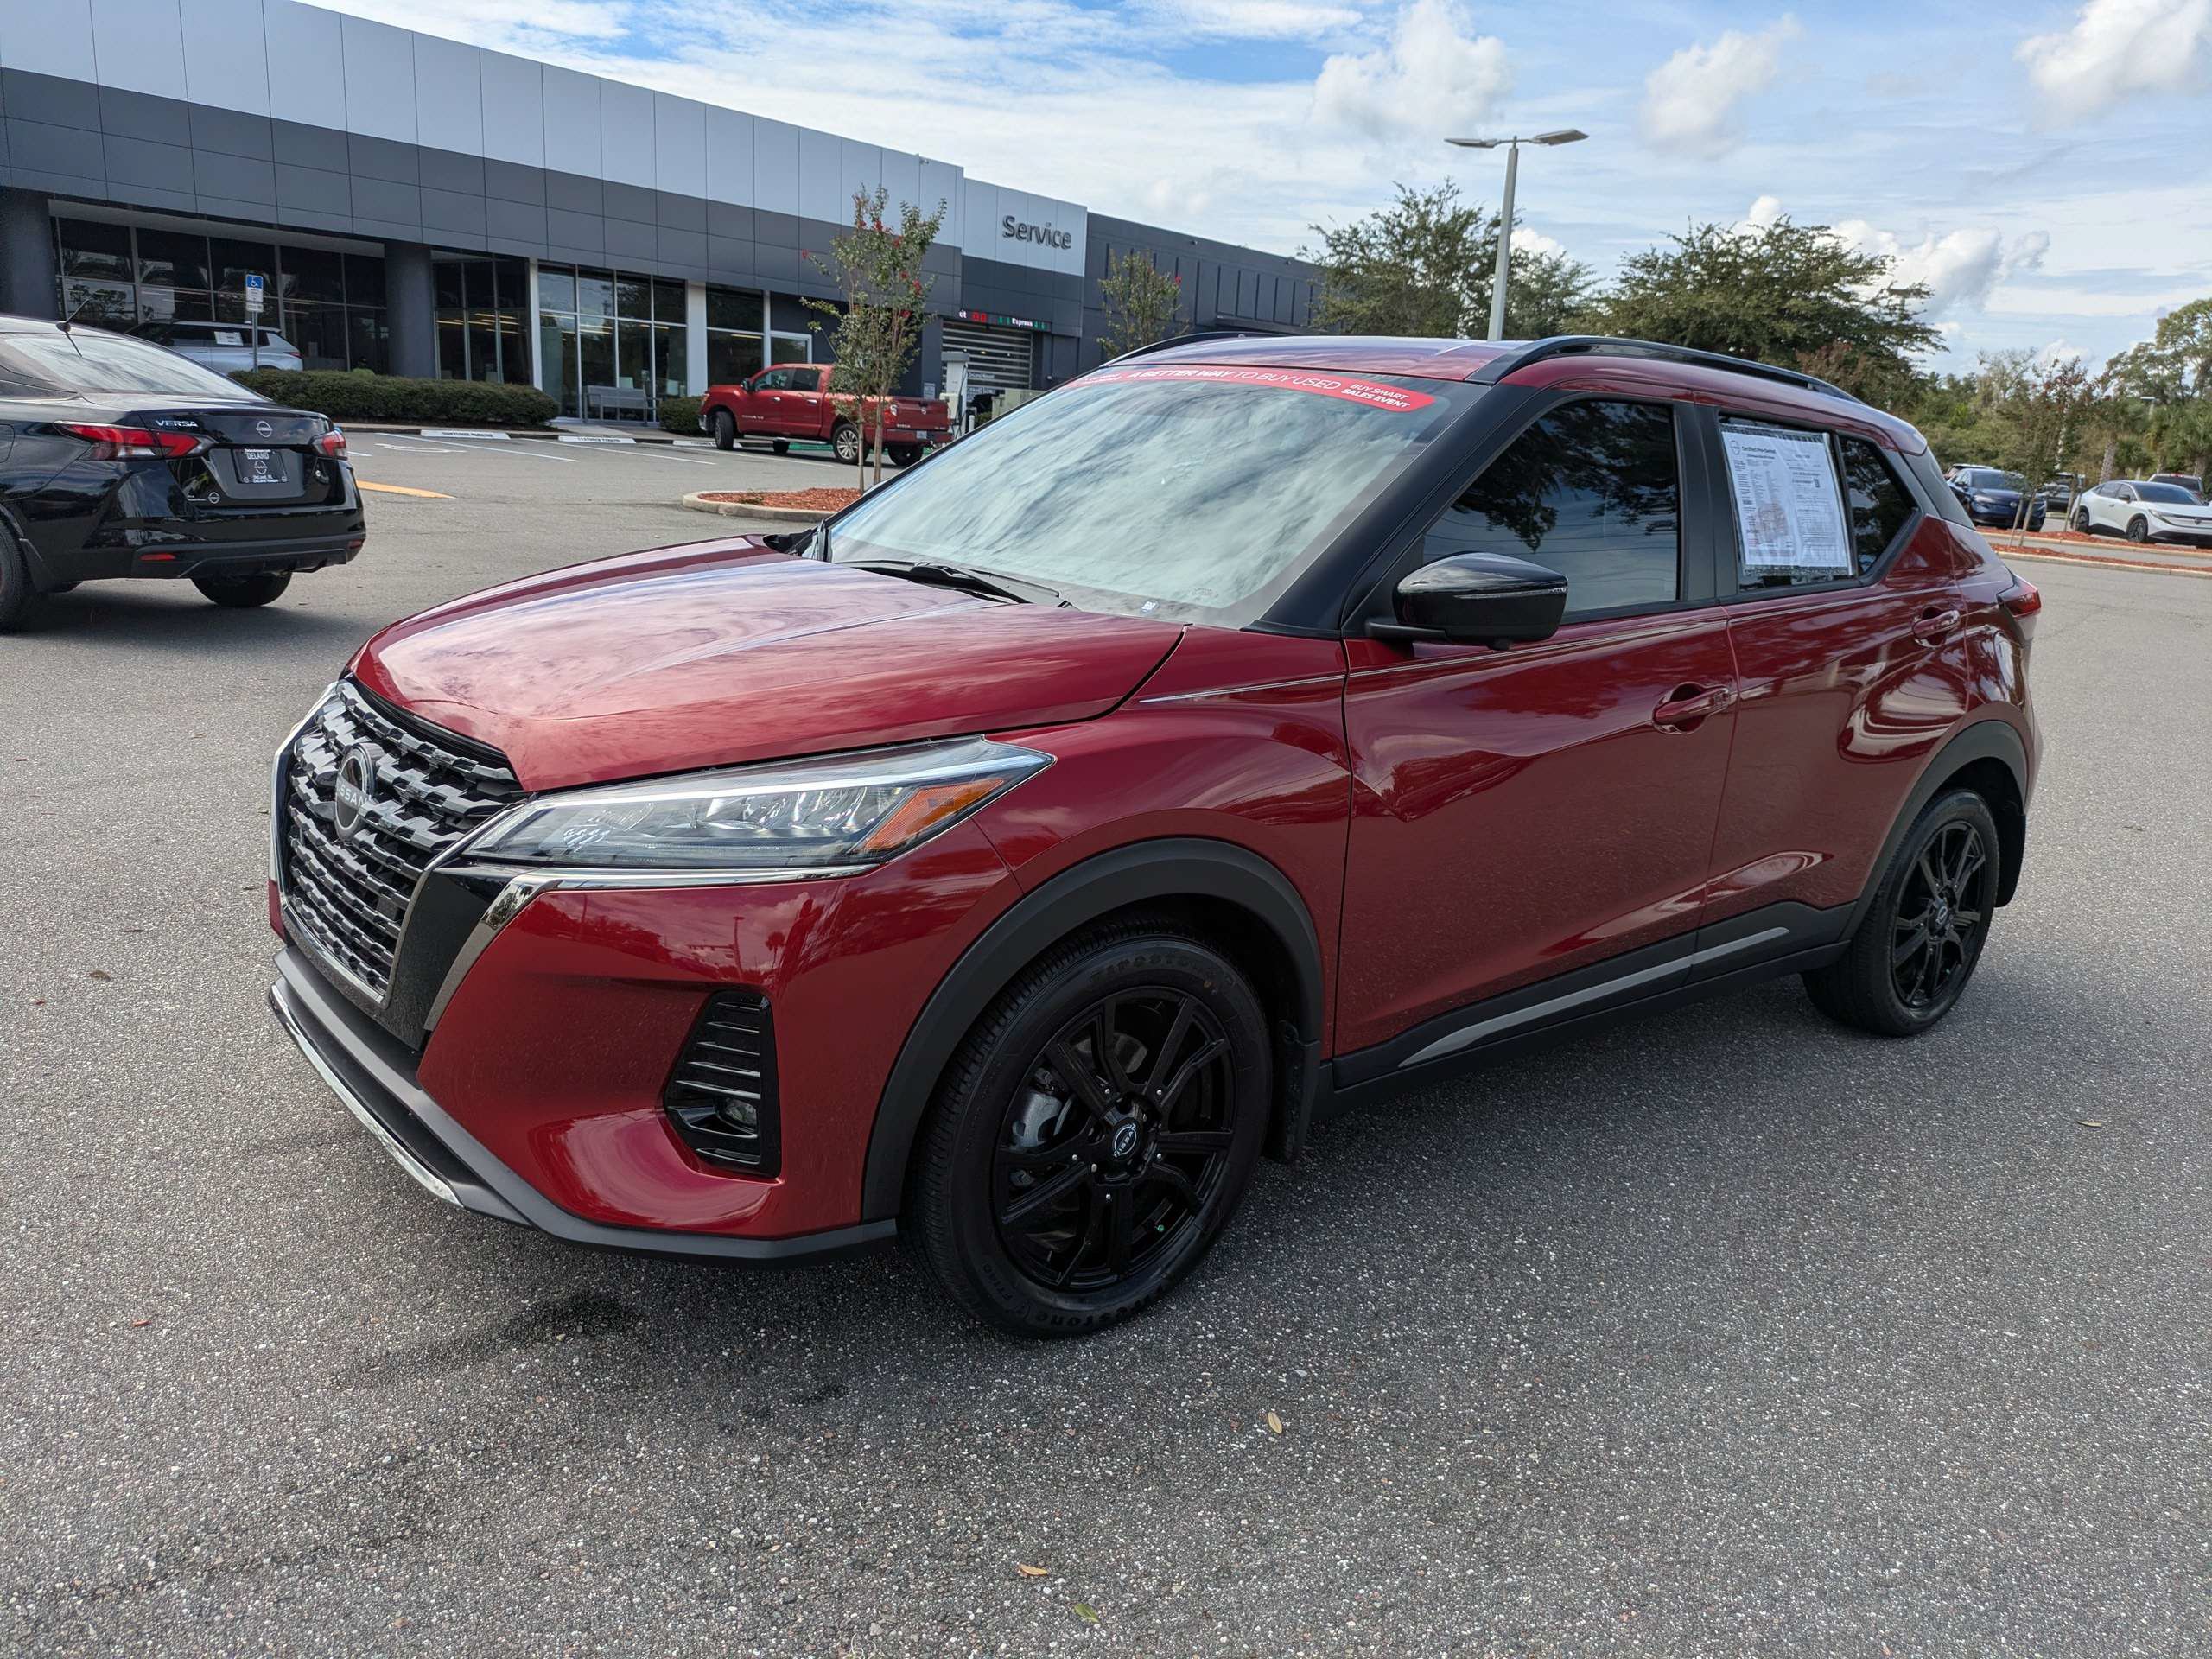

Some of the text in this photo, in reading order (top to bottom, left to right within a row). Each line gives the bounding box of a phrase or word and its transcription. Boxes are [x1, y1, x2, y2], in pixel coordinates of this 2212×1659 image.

[1002, 215, 1071, 250] Service
[1195, 369, 1235, 378] WAY
[1256, 373, 1293, 382] BUY
[1292, 377, 1342, 390] USED
[1341, 388, 1411, 408] SALES EVENT
[1350, 383, 1410, 400] BUY SMART
